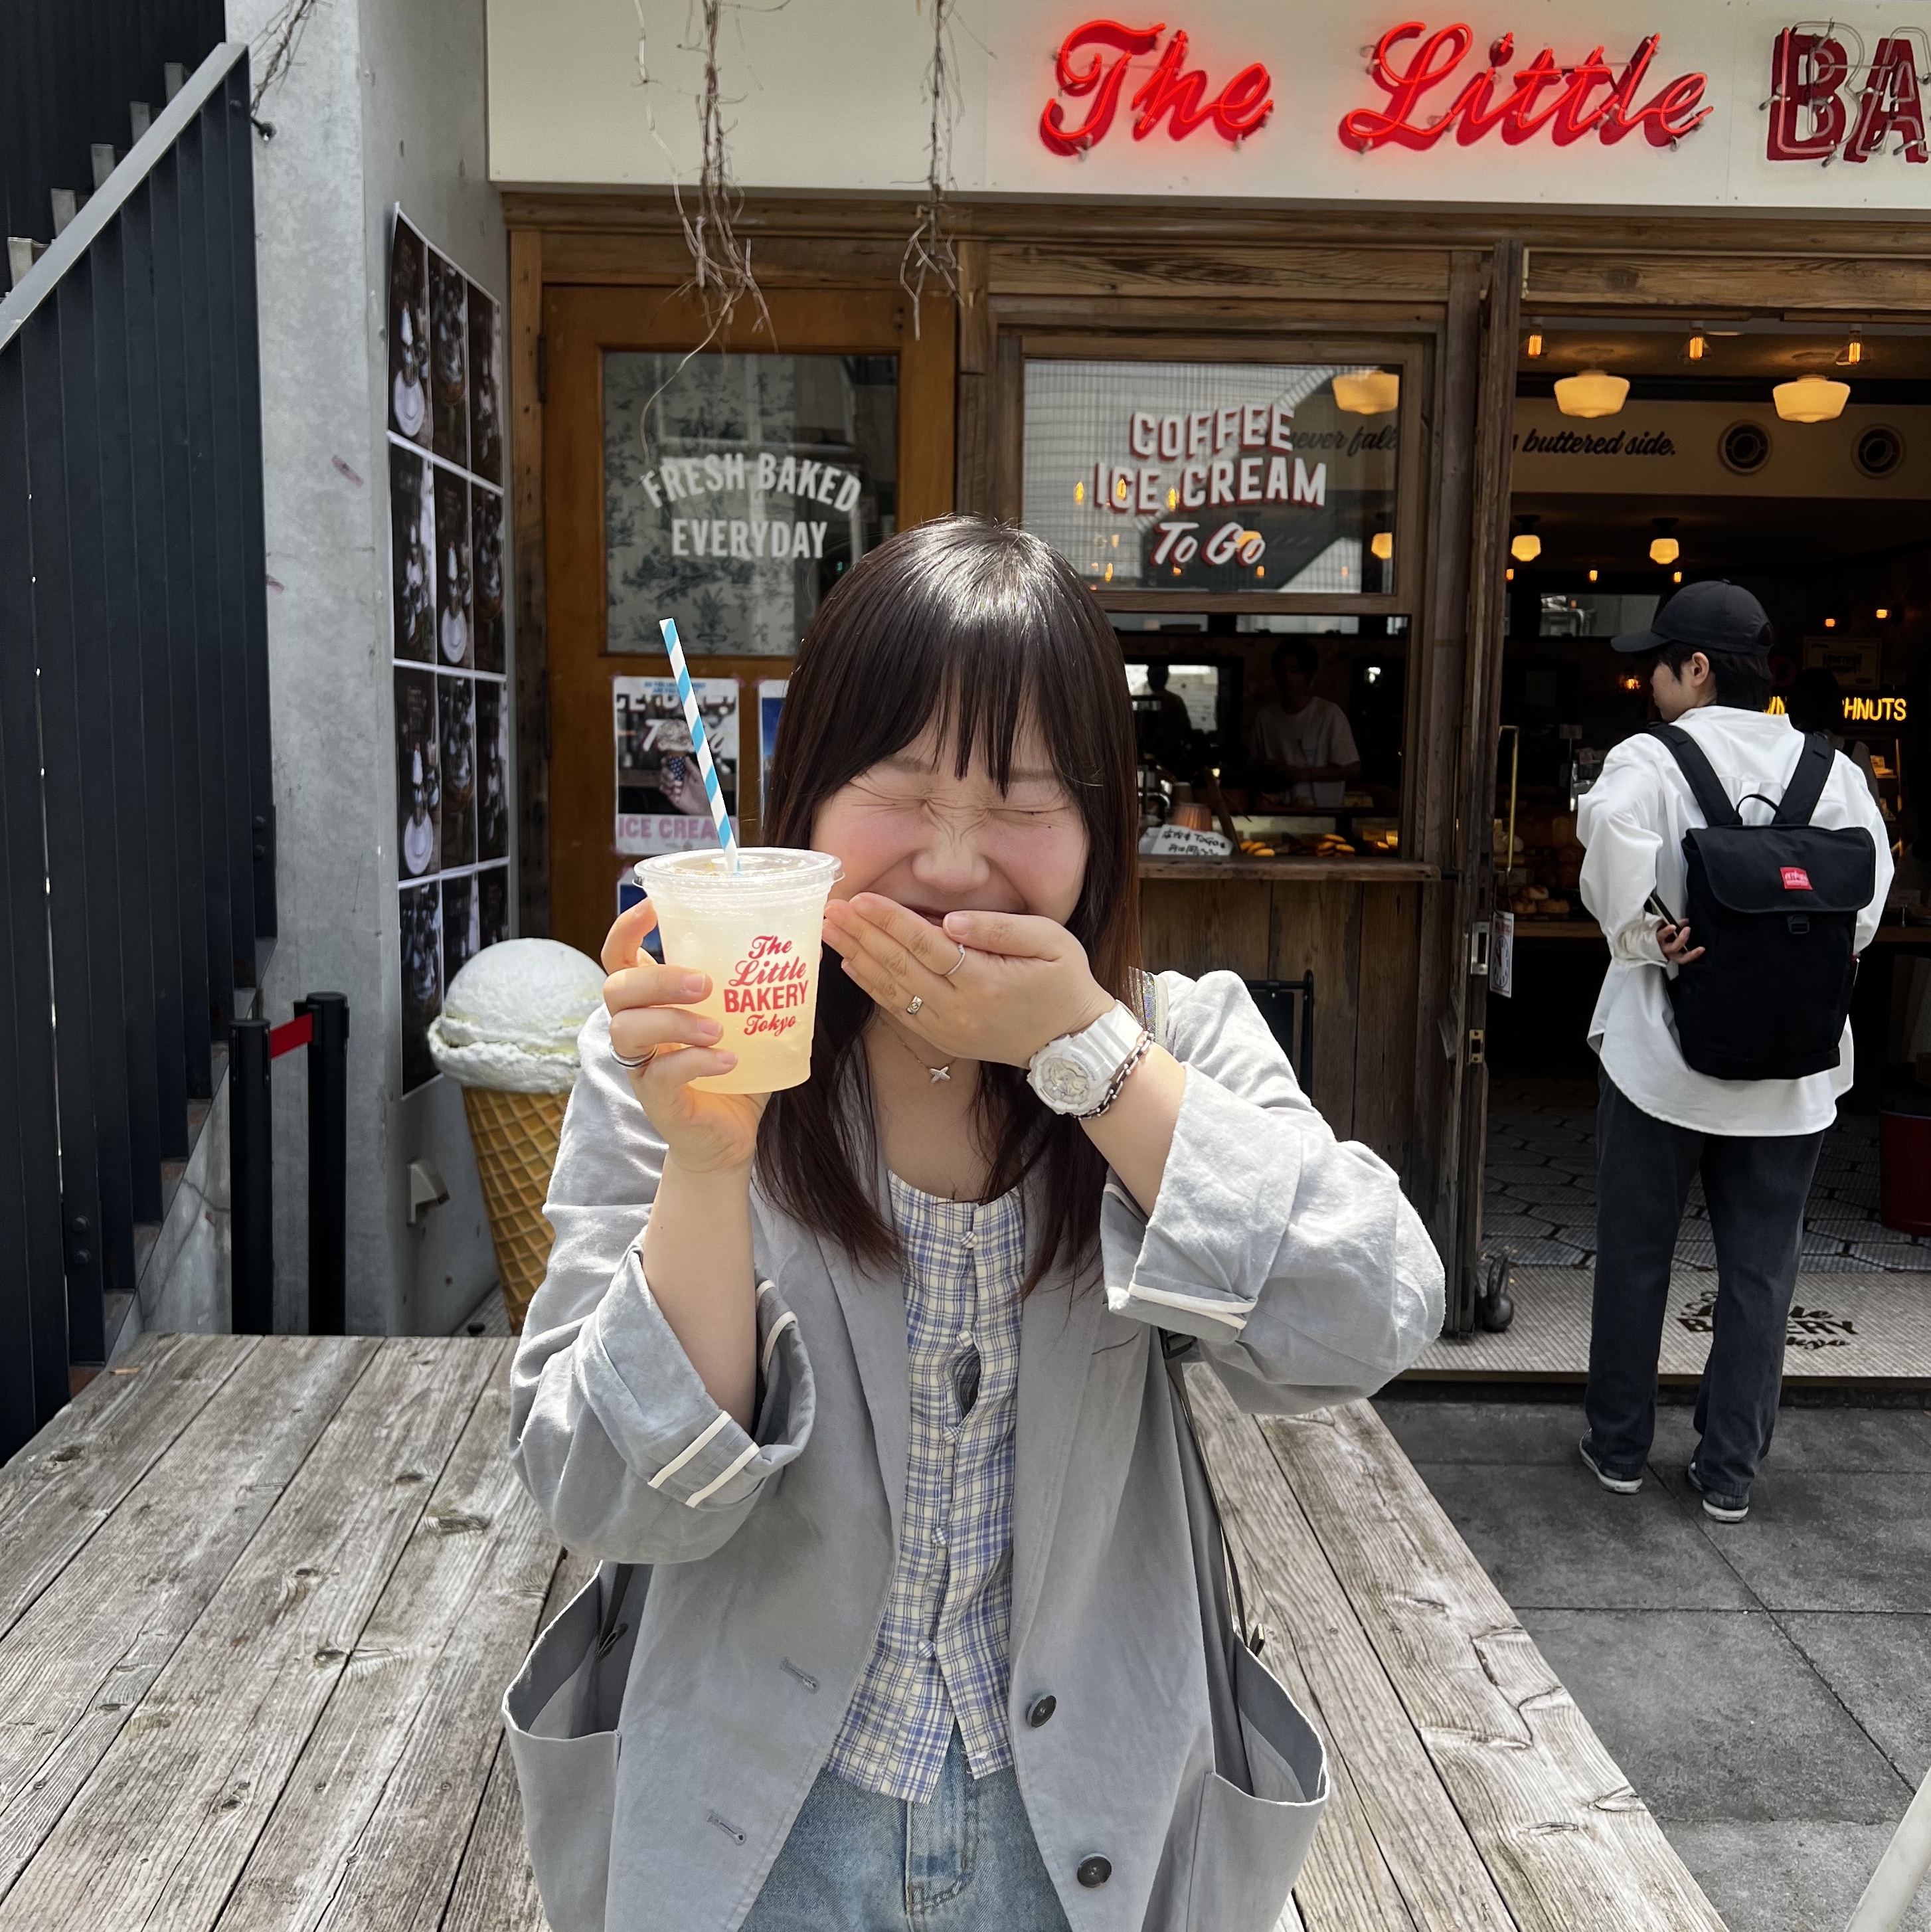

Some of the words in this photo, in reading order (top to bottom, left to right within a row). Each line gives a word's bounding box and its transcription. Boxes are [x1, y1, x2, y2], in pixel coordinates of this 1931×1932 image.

[1038, 21, 1275, 157] The
[1339, 21, 1716, 152] Little
[1130, 402, 1295, 461] COFFEE
[1522, 428, 1626, 454] buttered
[1624, 431, 1676, 457] side.
[641, 452, 745, 509] FRESH
[756, 452, 863, 512] BAKED
[1093, 462, 1162, 515] ICE
[1179, 457, 1327, 512] CREAM
[671, 519, 828, 560] EVERYDAY
[1150, 521, 1199, 567] To
[1201, 521, 1266, 567] Go
[619, 817, 652, 839] ICE
[748, 934, 793, 960] The
[728, 956, 807, 987] Little
[724, 980, 809, 1013] BAKERY
[743, 1013, 798, 1037] Tokyo
